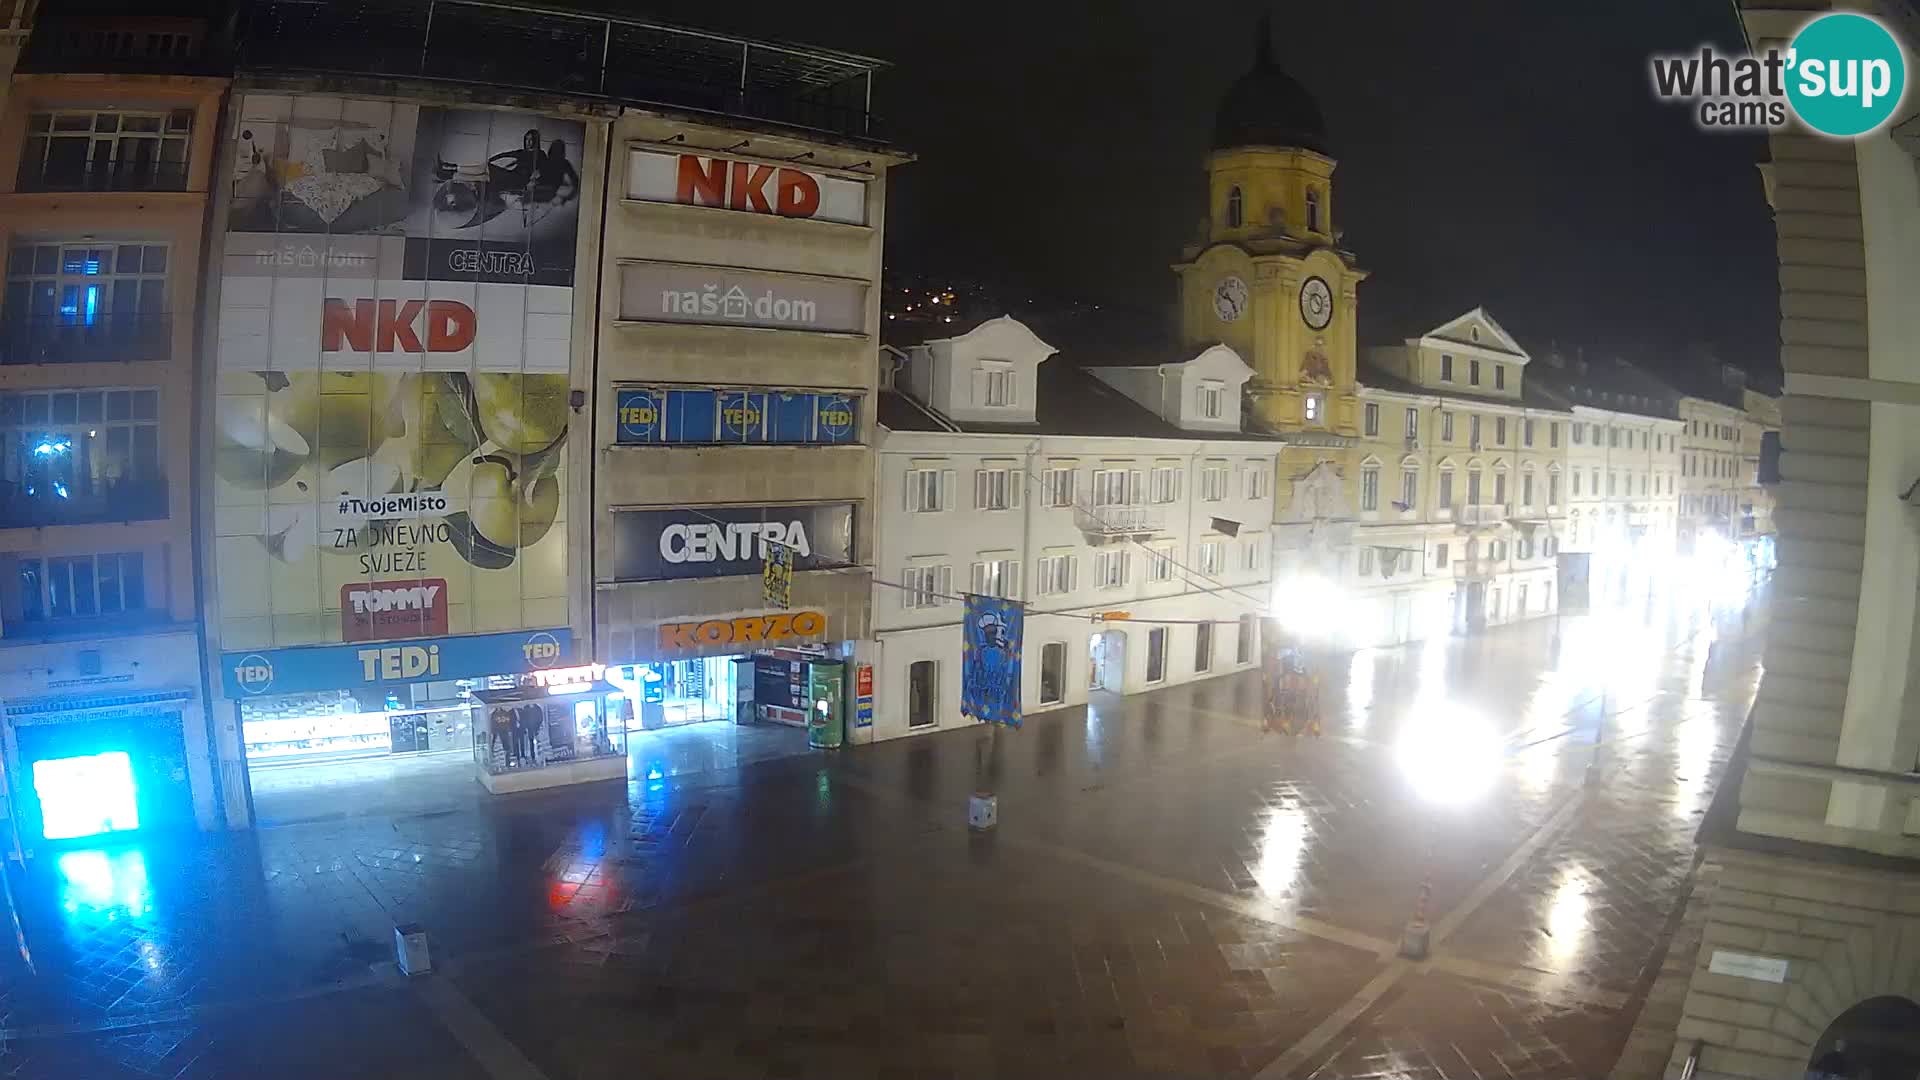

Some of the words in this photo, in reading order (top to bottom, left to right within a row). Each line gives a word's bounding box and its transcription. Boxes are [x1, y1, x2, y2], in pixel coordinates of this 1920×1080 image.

[676, 154, 820, 219] NKD
[448, 249, 535, 274] CENTRA
[661, 283, 719, 316] naš
[754, 290, 816, 322] dom
[322, 297, 477, 353] NKD
[619, 406, 658, 425] TEDi
[339, 496, 446, 516] #TvojeMisto
[334, 527, 358, 548] ZA
[368, 523, 450, 547] DNEVNO
[659, 520, 810, 564] CENTRA
[360, 546, 427, 574] SVJEŽE
[349, 585, 440, 614] TOMMY
[658, 610, 825, 650] KORZO
[358, 644, 440, 681] TEDi
[522, 643, 561, 660] TEDi
[234, 665, 274, 683] TEDi
